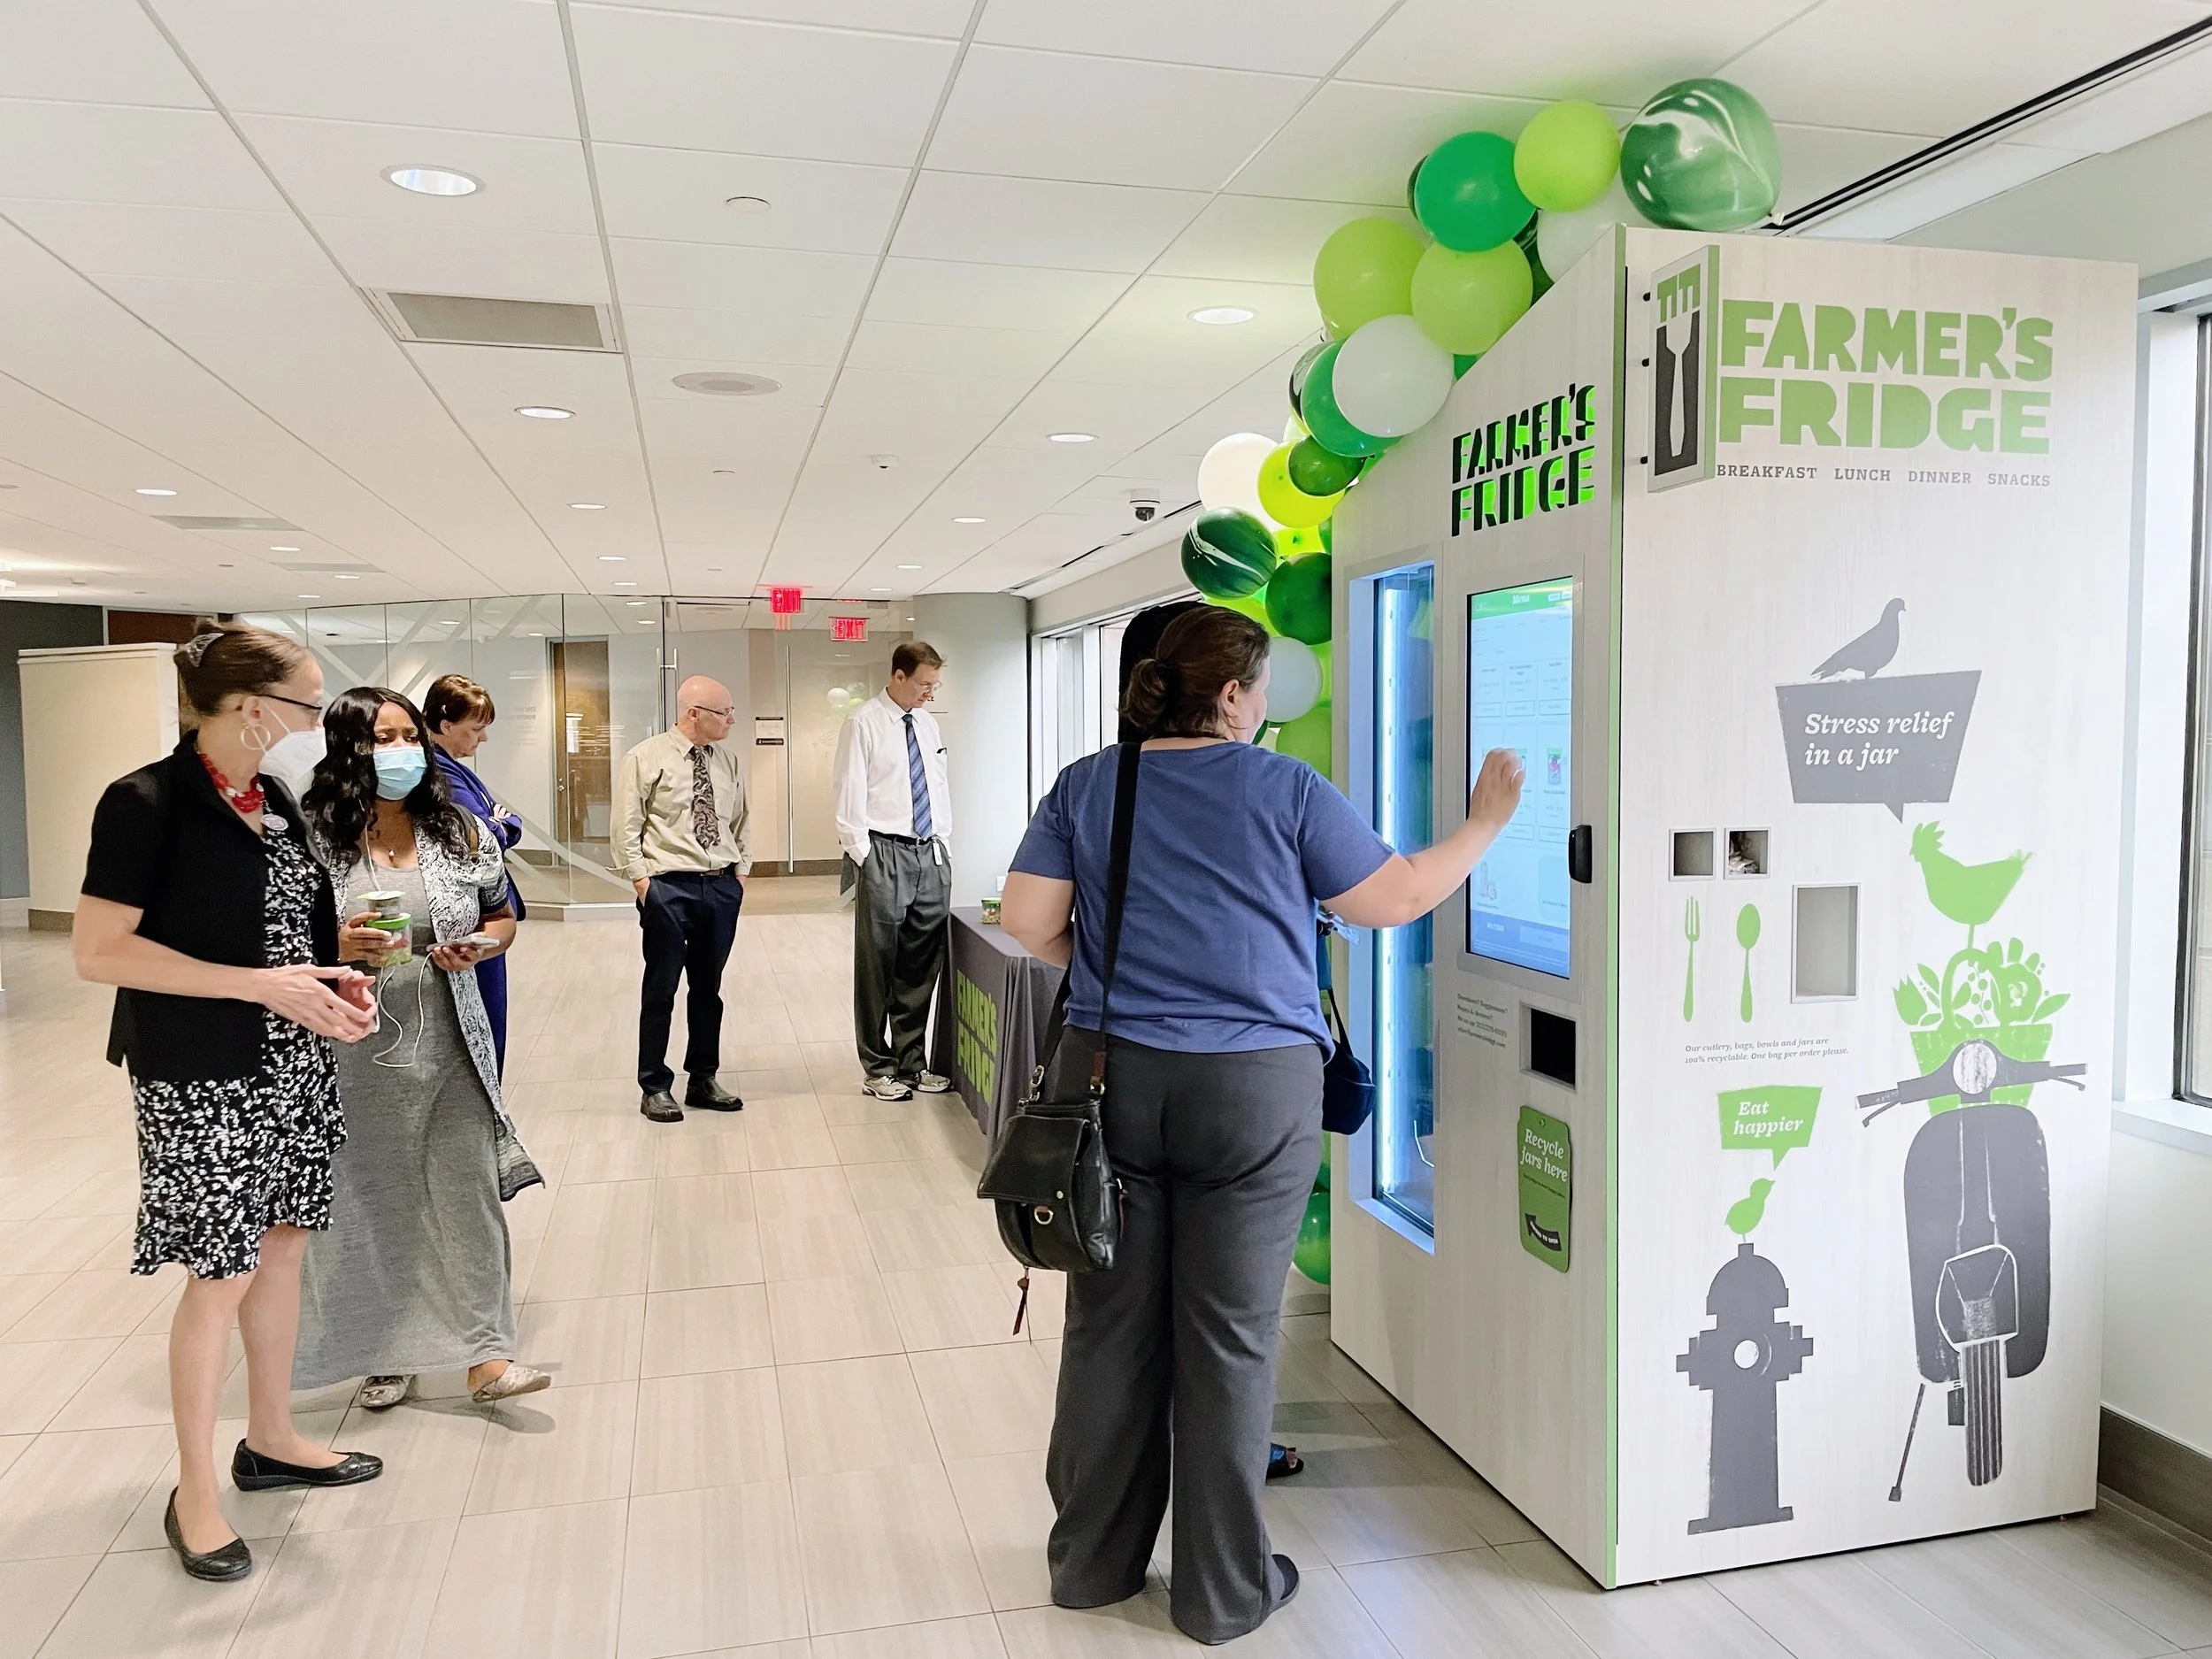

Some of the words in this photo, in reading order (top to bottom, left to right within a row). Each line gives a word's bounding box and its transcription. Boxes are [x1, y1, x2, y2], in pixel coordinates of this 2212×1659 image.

[1721, 299, 2054, 382] FARMER'S
[1719, 376, 2052, 455] FRIDGE
[1452, 383, 1596, 484] FARMER'S
[1451, 445, 1596, 537] FRIDGE
[1717, 465, 1817, 480] BREAKFAST
[1834, 468, 1892, 482] LUNCH
[1908, 471, 1972, 485] DINNER
[1987, 473, 2052, 488] SNACKS
[772, 588, 803, 613] EXIT
[836, 618, 865, 639] EXIT
[1804, 713, 1881, 735] Stress
[1886, 710, 1955, 740] relief
[1804, 742, 1831, 766] in
[1837, 749, 1854, 765] a
[1855, 741, 1900, 772] jar
[1685, 1056, 1706, 1064] 100%
[1707, 1053, 1749, 1064] recyclable.
[1768, 1051, 1783, 1061] bag
[1783, 1050, 1798, 1060] per
[1799, 1048, 1822, 1057] order
[1822, 1048, 1849, 1057] please.
[1702, 1043, 1732, 1053] cutlery,
[1734, 1041, 1755, 1051] bags,
[1756, 1041, 1779, 1049] bowls
[1796, 1038, 1815, 1048] jars
[1738, 1101, 1770, 1116] Eat
[1732, 1116, 1804, 1138] happier
[1525, 1128, 1564, 1160] Recycle
[1519, 1145, 1543, 1170] jars
[1543, 1156, 1568, 1183] here
